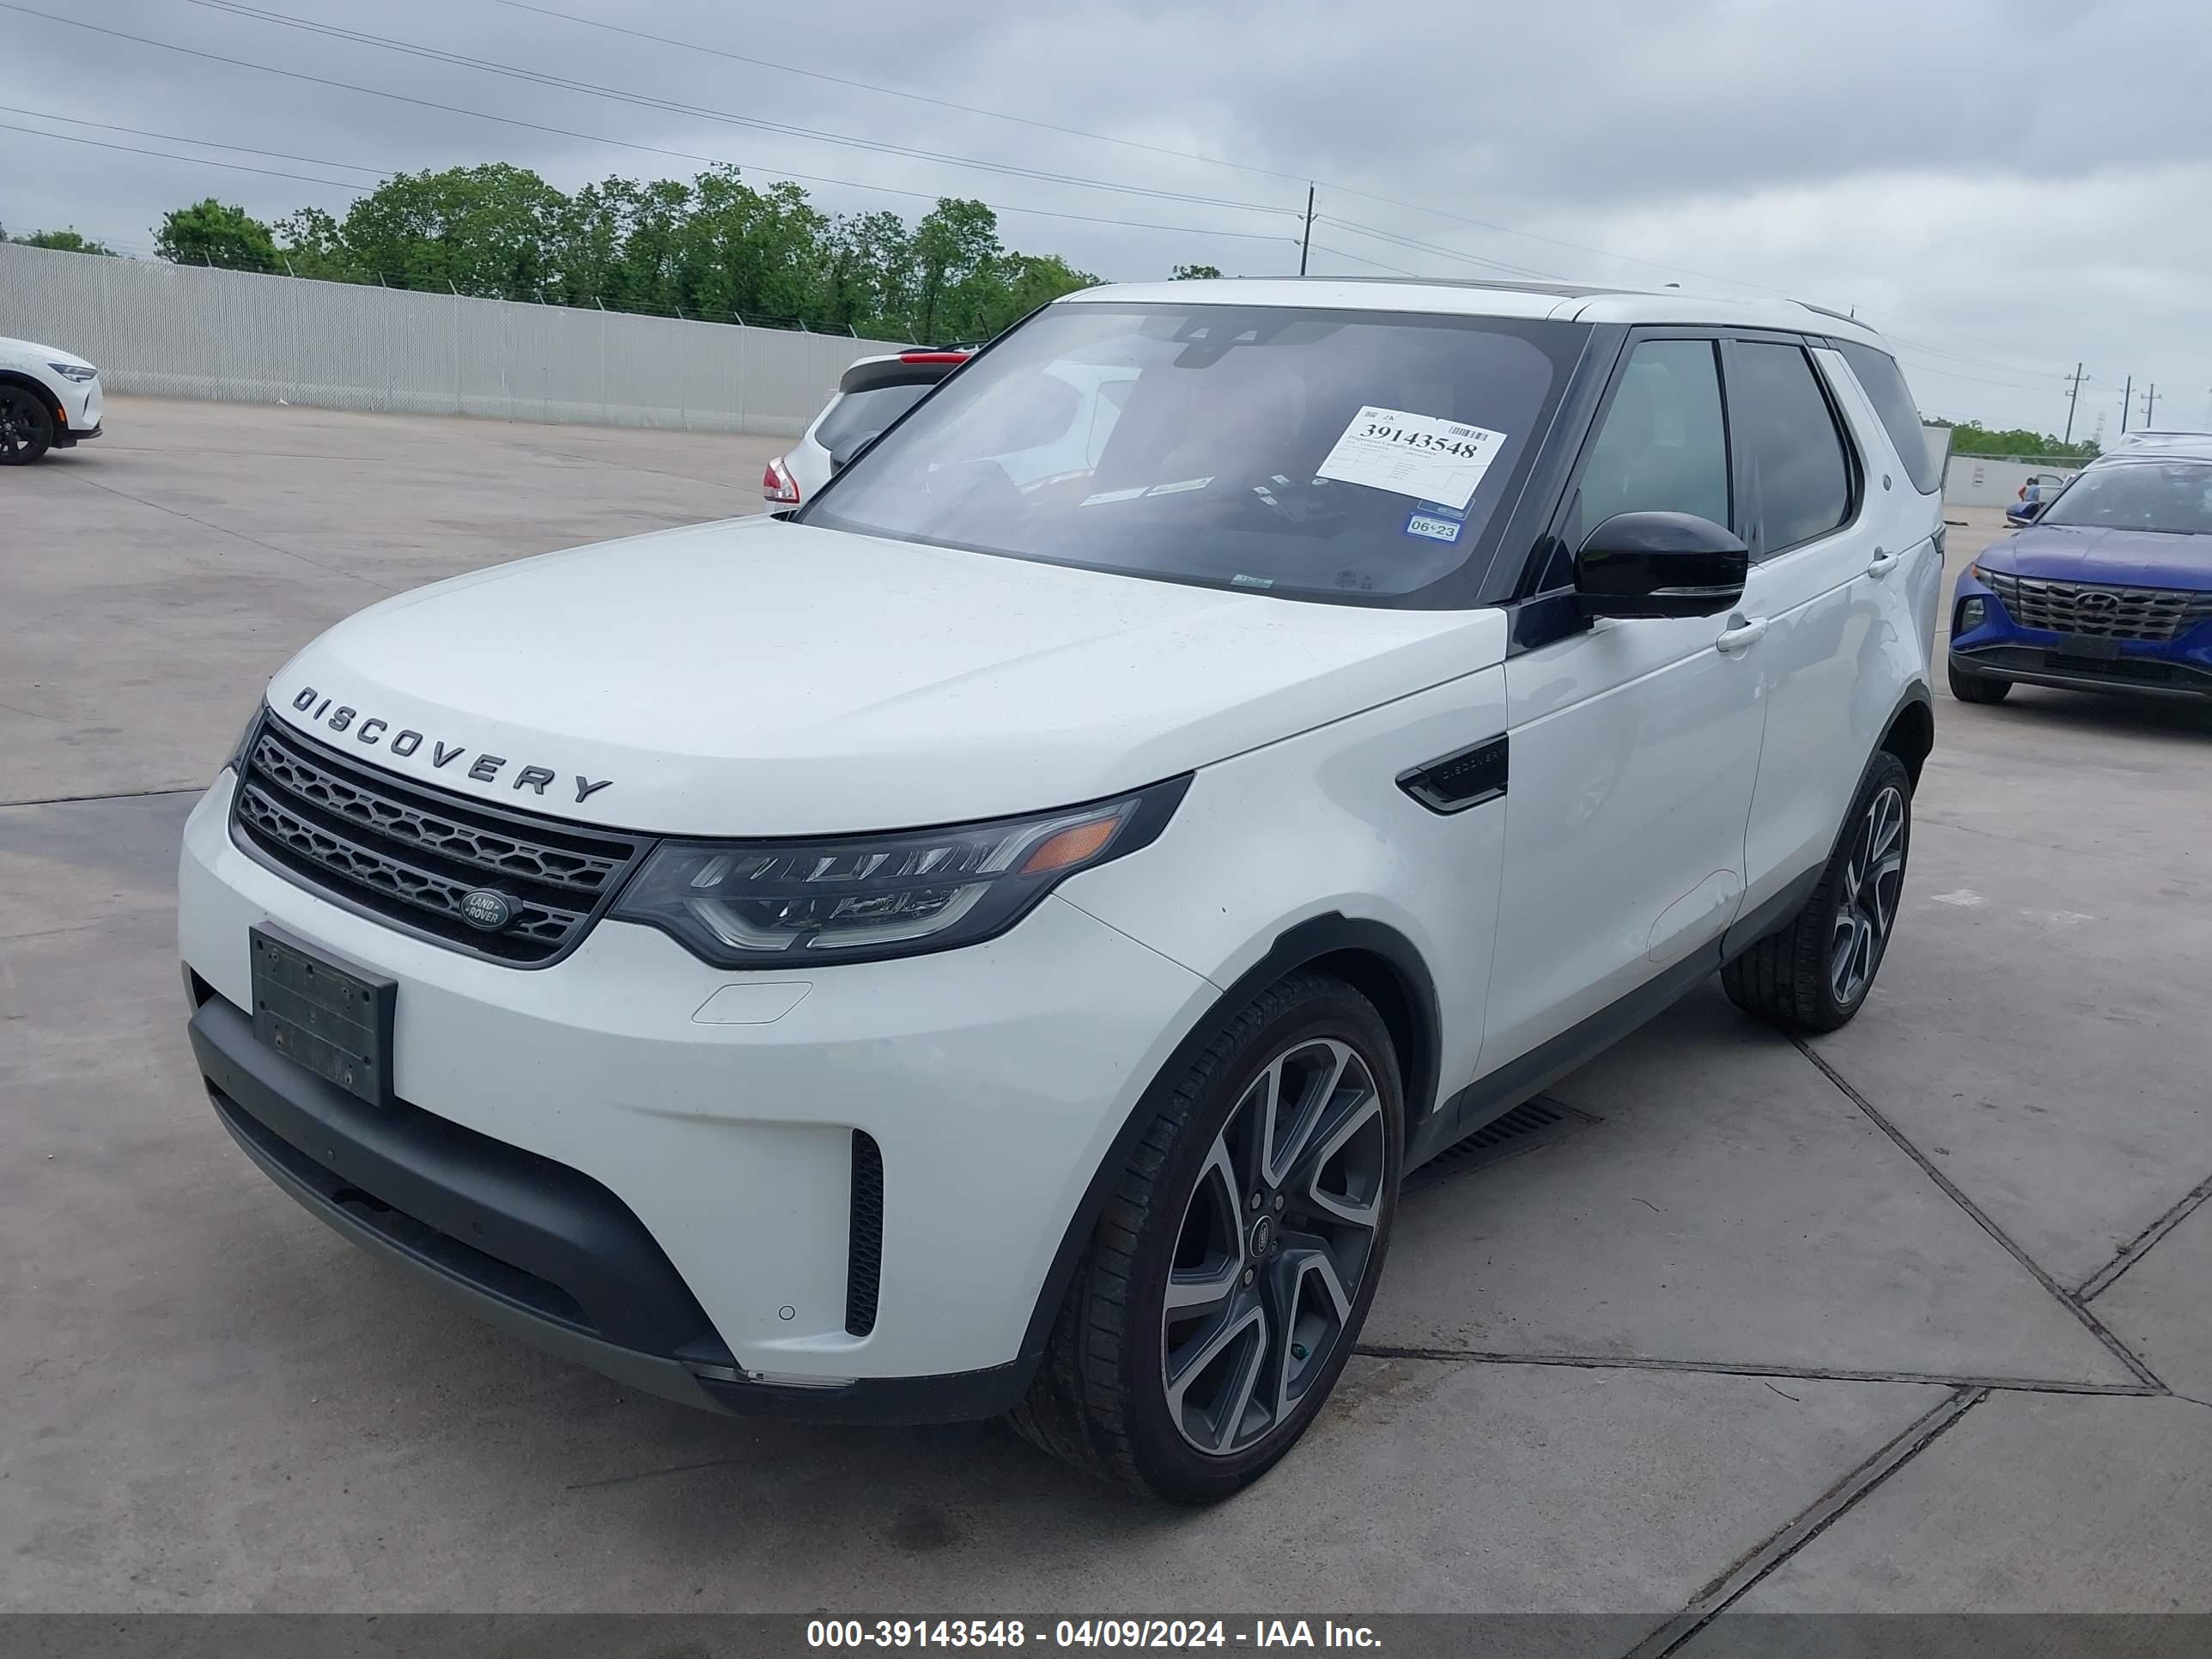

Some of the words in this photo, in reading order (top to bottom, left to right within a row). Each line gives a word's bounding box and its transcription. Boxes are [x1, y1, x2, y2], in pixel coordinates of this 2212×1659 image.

[1359, 423, 1478, 459] 39143548
[292, 686, 614, 804] DISCOVERY
[468, 907, 499, 924] ROVER
[470, 896, 495, 910] LAND
